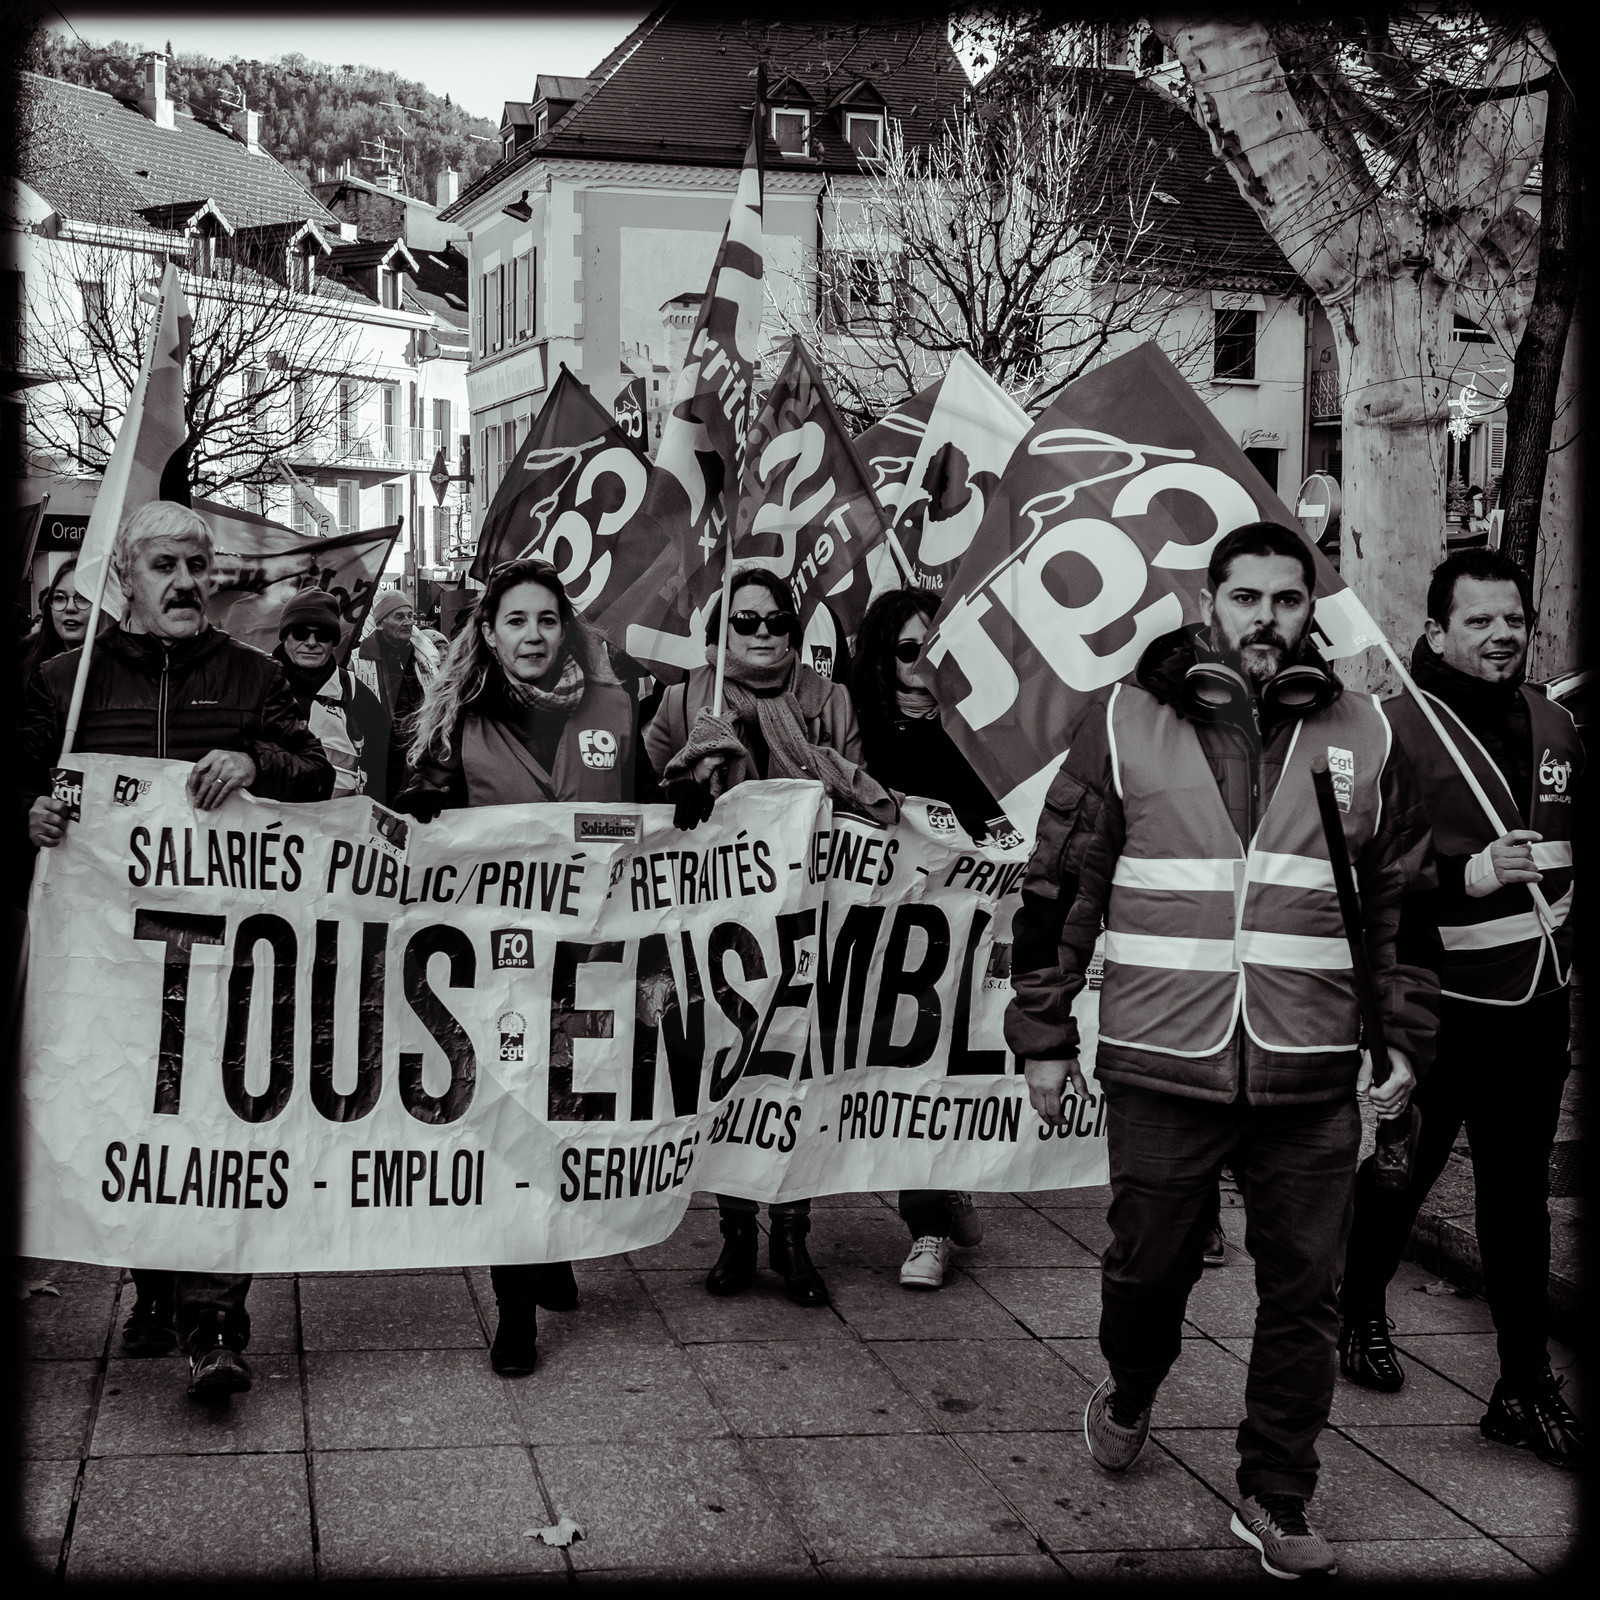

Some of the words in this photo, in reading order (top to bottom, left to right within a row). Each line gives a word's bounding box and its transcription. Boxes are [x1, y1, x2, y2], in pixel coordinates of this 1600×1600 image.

[51, 521, 87, 539] Oran
[815, 657, 832, 677] cgt
[578, 729, 616, 752] FO
[583, 753, 615, 767] COM
[1330, 755, 1353, 770] cgt
[581, 821, 636, 836] Solidaires
[929, 813, 956, 829] cgt
[997, 829, 1025, 848] cgt
[129, 821, 305, 892] SALARIÉS
[327, 840, 587, 917] PUBLIC/PRIVÉ
[630, 830, 777, 912] RETRAITÉS
[498, 933, 529, 959] FO
[133, 908, 477, 1125] TOUS
[546, 902, 1025, 1121] ENSEMBL
[499, 1044, 526, 1060] cgt
[102, 1142, 289, 1210] SALAIRES
[351, 1149, 485, 1208] EMPLOI
[560, 1131, 700, 1203] SERVICE
[707, 1098, 802, 1153] BLICS
[838, 1092, 1023, 1143] PROTECTION
